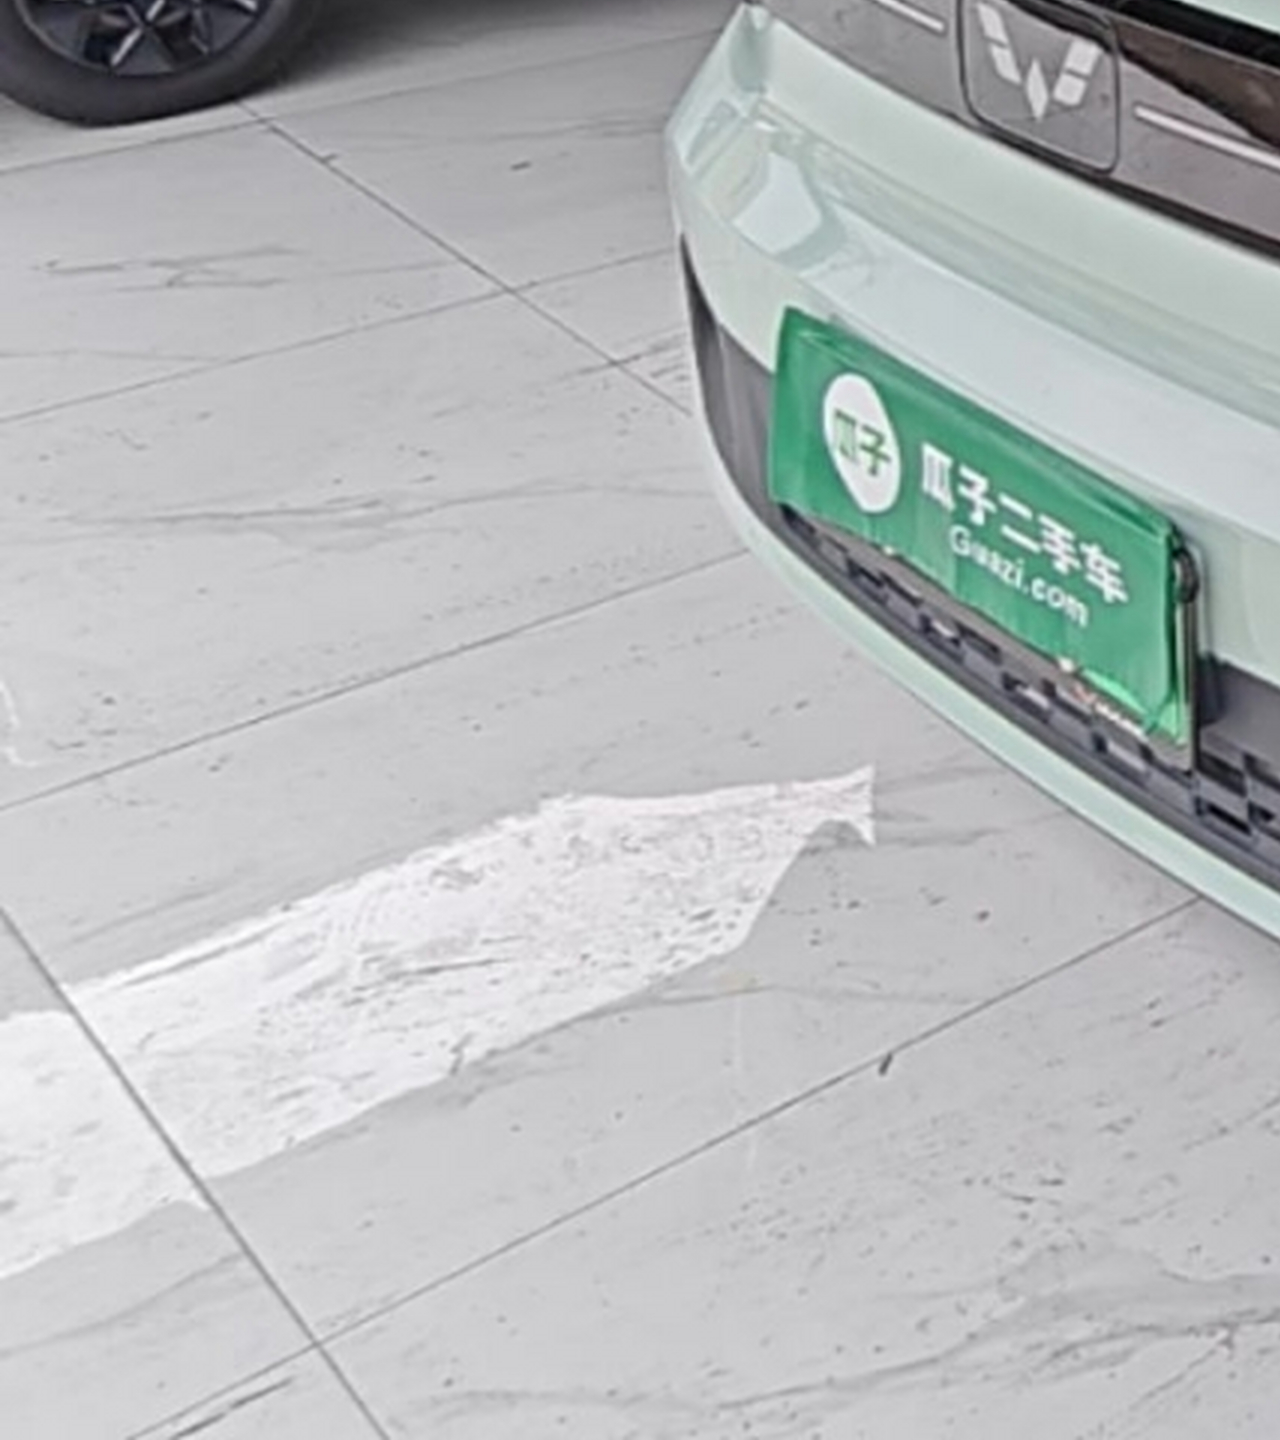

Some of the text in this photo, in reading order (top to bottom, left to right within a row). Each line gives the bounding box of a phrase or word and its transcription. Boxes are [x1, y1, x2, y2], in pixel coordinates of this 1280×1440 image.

[833, 409, 891, 477] 瓜子
[921, 442, 1128, 604] 瓜子二手车
[949, 525, 1088, 627] Guazi.com
